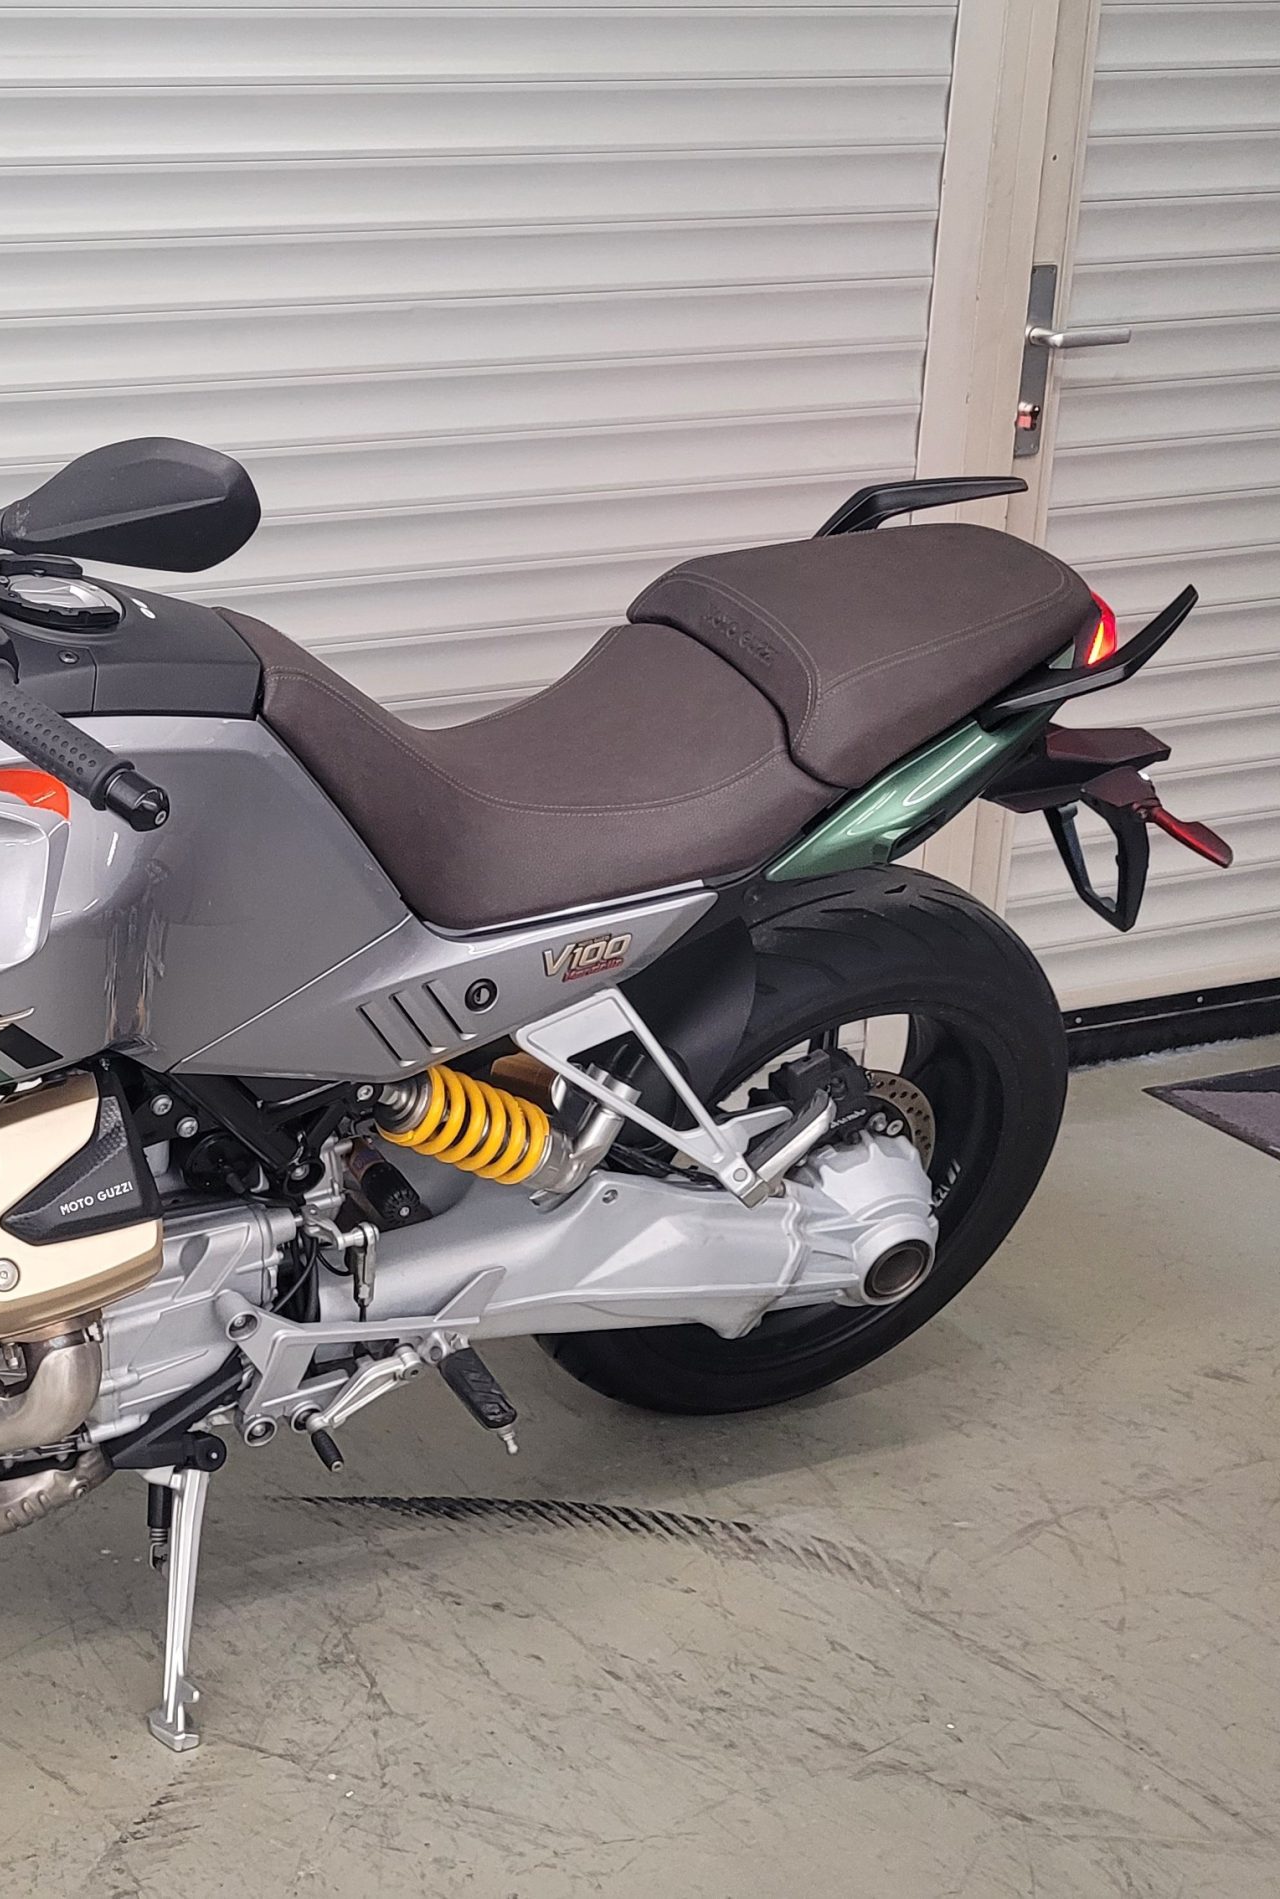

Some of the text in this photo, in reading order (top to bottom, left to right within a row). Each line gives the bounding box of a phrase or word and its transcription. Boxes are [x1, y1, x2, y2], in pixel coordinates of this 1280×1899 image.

[542, 933, 632, 977] V100
[59, 1180, 134, 1216] MOTO GUZZI
